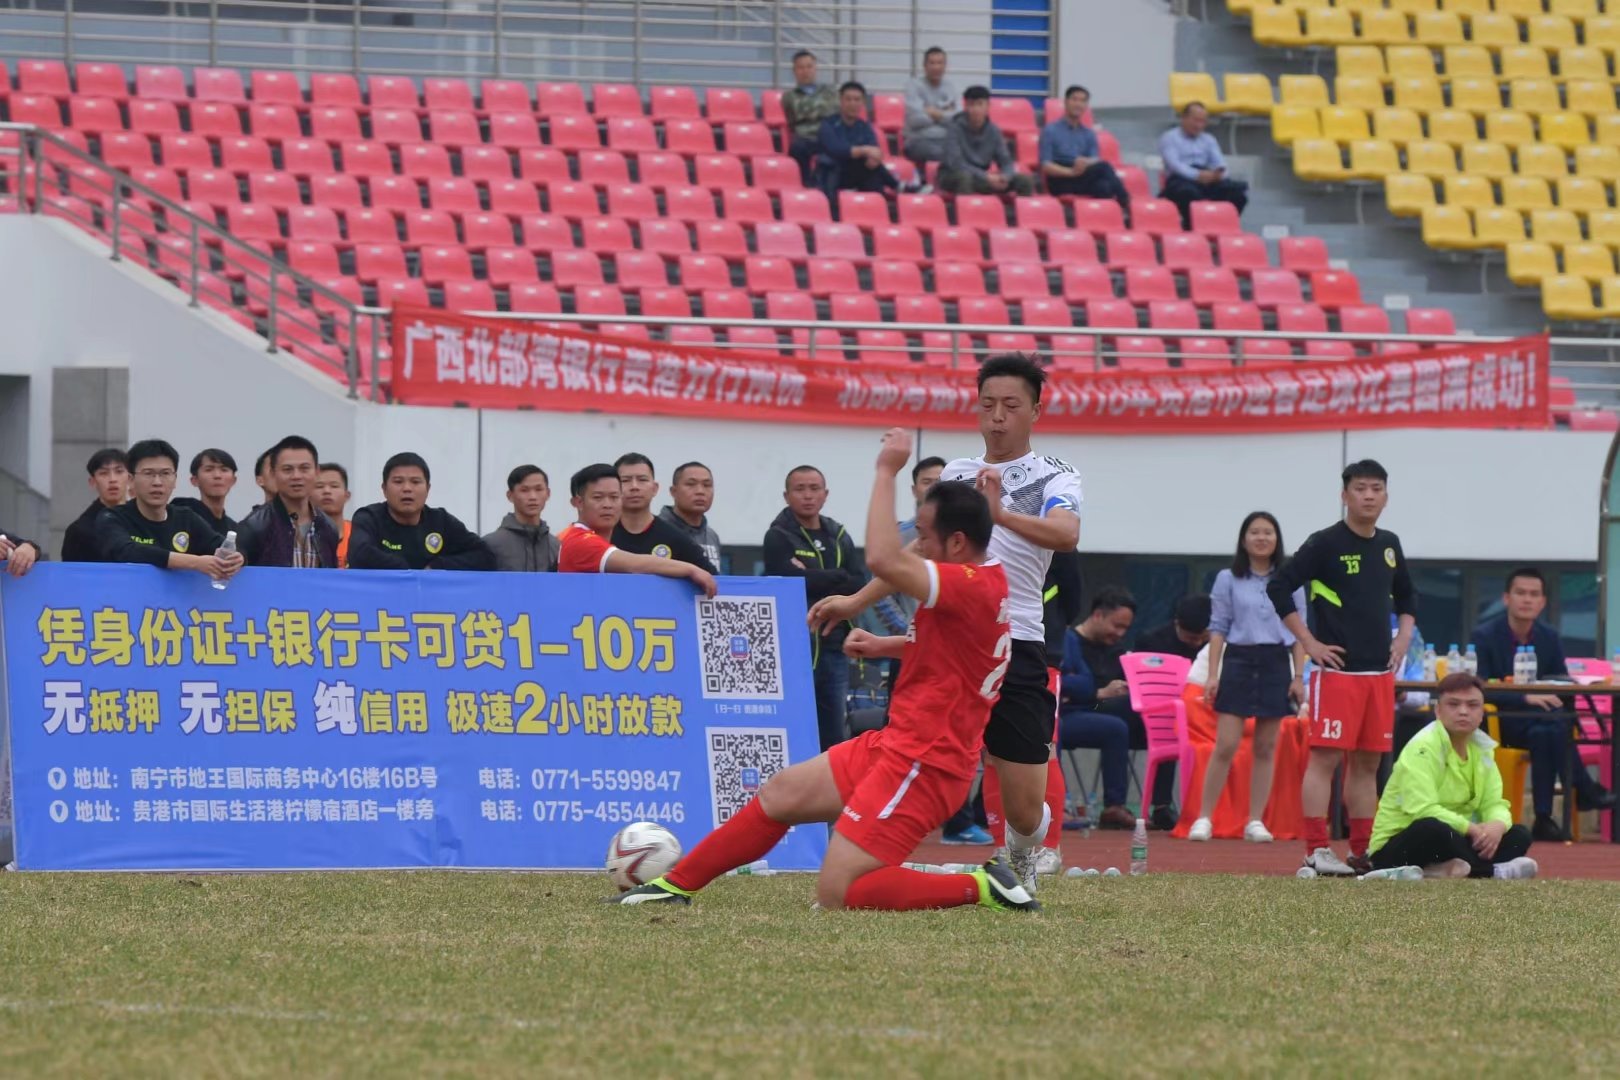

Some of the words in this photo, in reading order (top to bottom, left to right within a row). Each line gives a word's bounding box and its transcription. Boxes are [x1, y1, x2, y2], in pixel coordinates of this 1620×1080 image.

[1346, 561, 1360, 574] 13
[38, 607, 677, 673] 凭身份证+银行卡可贷1-10万
[43, 681, 160, 735] 无抵押
[180, 681, 297, 735] 无担保
[313, 681, 429, 736] 纯信用
[447, 680, 684, 738] 极速2小时放款
[1321, 718, 1342, 740] 13
